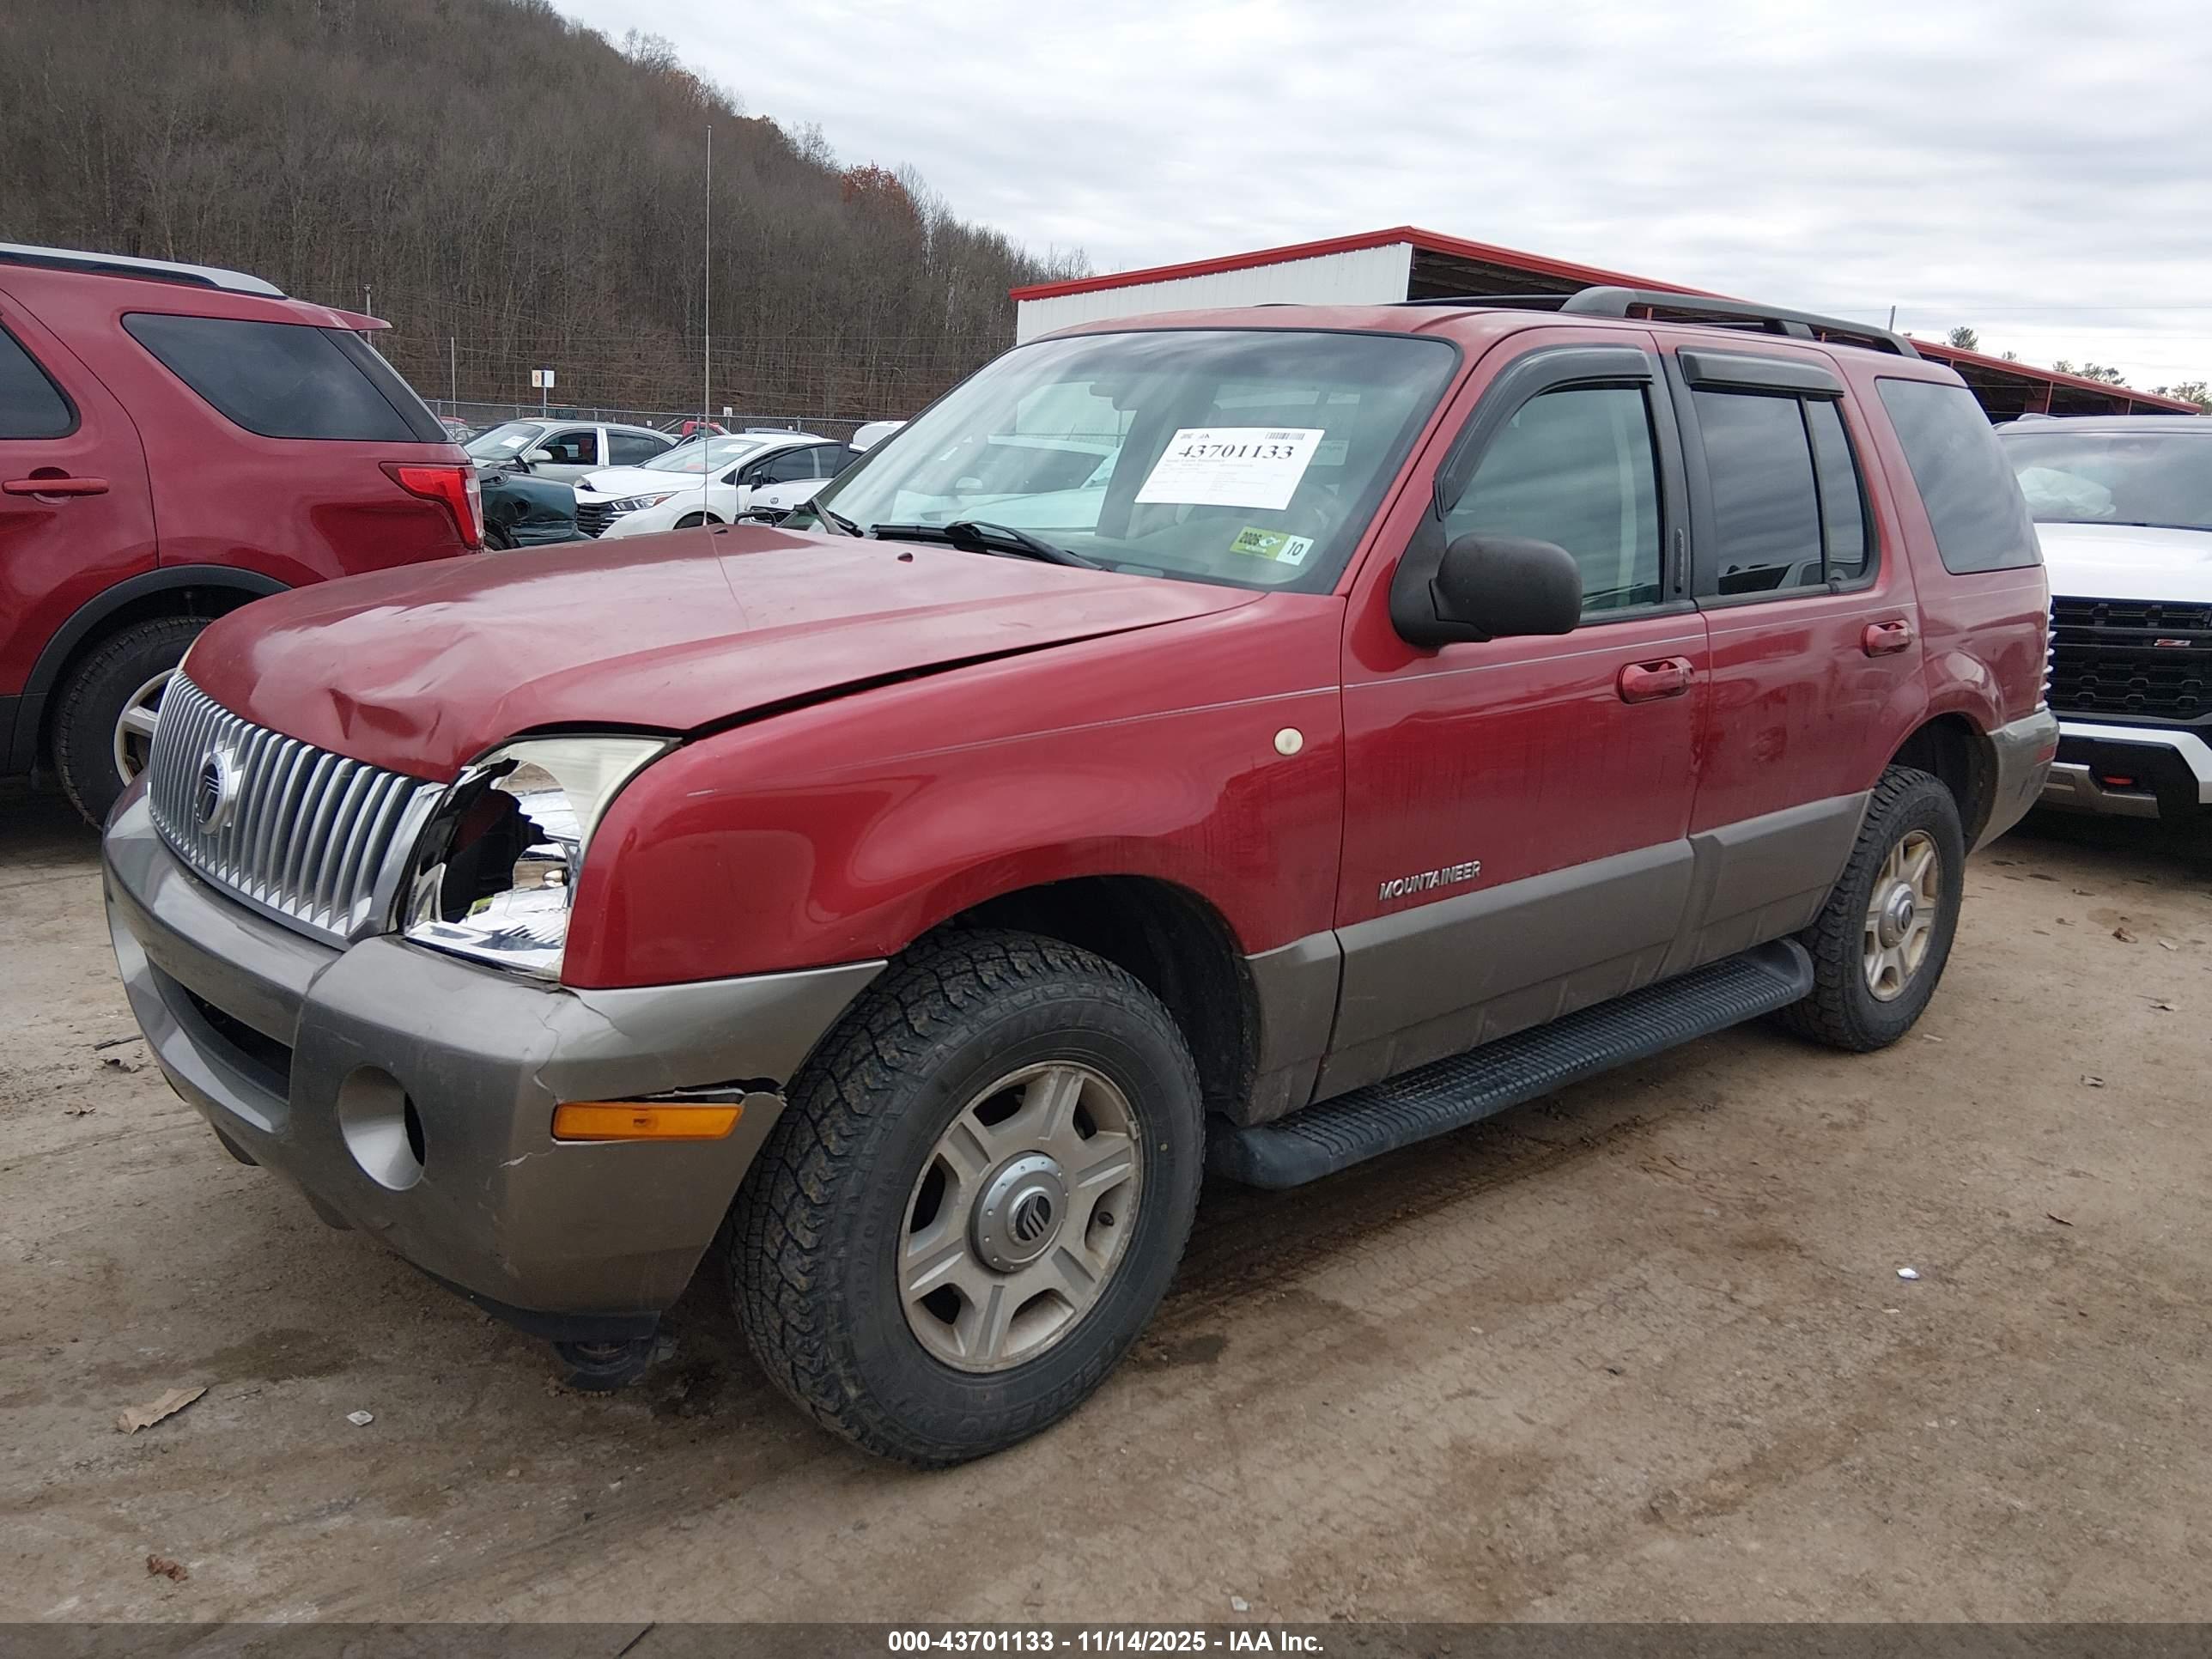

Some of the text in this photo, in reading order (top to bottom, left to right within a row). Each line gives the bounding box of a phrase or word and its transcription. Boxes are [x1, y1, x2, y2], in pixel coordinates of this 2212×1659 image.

[1178, 444, 1295, 459] 43701133
[1286, 541, 1304, 557] 10
[1378, 860, 1482, 900] MOUNTAINEER
